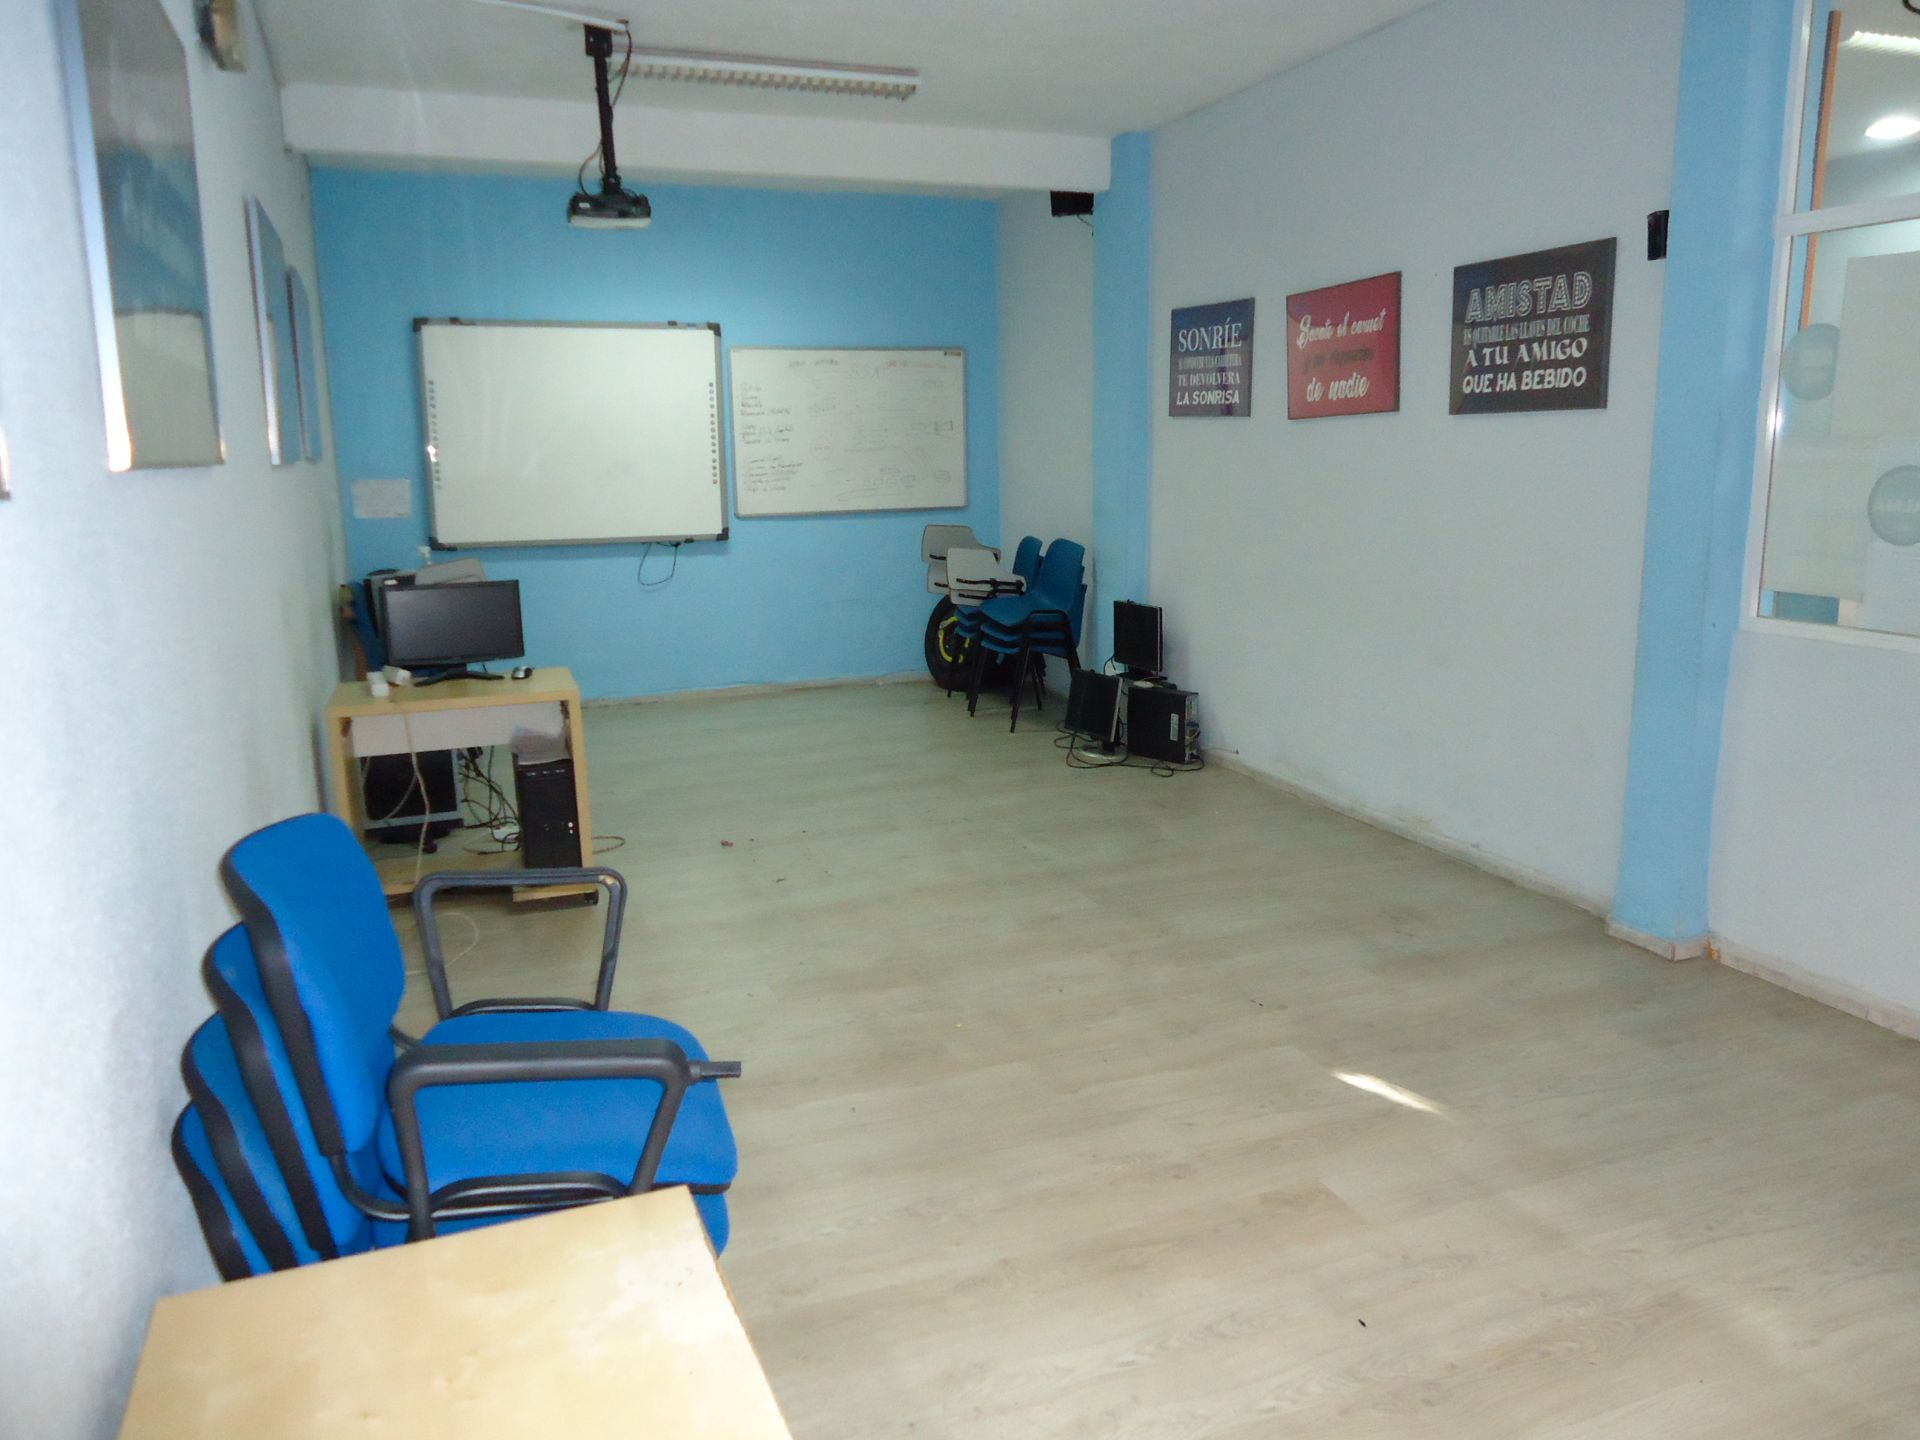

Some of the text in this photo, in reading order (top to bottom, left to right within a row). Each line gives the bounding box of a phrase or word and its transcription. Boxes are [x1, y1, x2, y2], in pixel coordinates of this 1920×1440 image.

[1465, 271, 1593, 324] AMISTAD
[1178, 317, 1242, 353] SONRÍE
[1464, 337, 1588, 368] A TU AMIGO
[1306, 372, 1370, 402] de nadie
[1462, 366, 1587, 394] QUE HA BEBIDO
[1176, 389, 1240, 405] LA SONRISA
